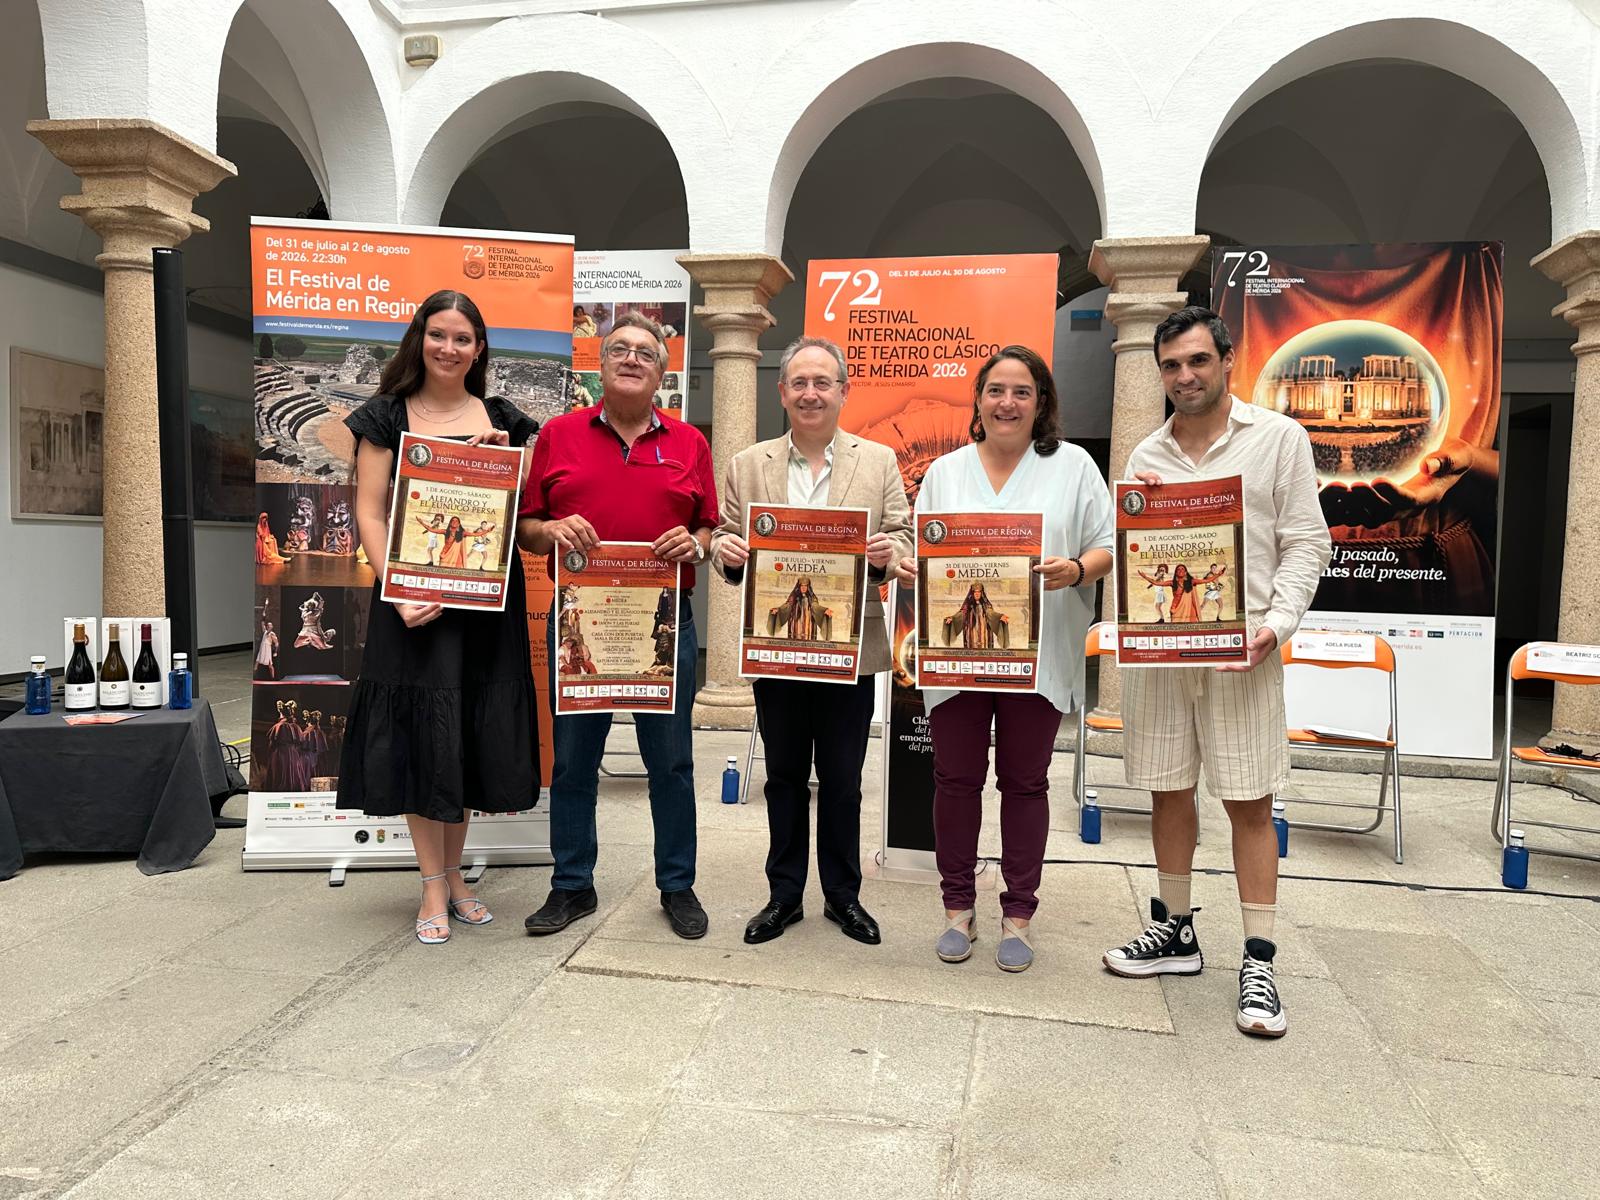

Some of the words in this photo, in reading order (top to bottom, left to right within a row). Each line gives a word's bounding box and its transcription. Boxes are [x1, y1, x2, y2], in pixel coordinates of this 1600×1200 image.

[266, 237, 282, 248] Del
[286, 238, 297, 248] 31
[301, 239, 313, 249] de
[316, 240, 338, 251] julio
[340, 242, 350, 252] al
[352, 242, 359, 252] 2
[362, 243, 374, 252] de
[376, 244, 410, 255] agosto
[266, 251, 278, 260] de
[281, 252, 310, 262] 2026.
[312, 254, 346, 264] 22:30h
[463, 245, 484, 260] 72
[488, 255, 542, 264] INTERNACIONAL
[1223, 250, 1270, 287] 72
[266, 268, 282, 286] El
[290, 270, 362, 290] Festival
[368, 274, 390, 292] de
[578, 270, 642, 279] INTERNACIONAL
[584, 280, 618, 288] CLÁSICO
[664, 280, 682, 288] 2026
[266, 290, 330, 311] Mérida
[336, 299, 358, 312] en
[818, 270, 882, 322] 72
[849, 310, 918, 324] FESTIVAL
[848, 327, 975, 342] INTERNACIONAL
[848, 346, 866, 360] DE
[872, 346, 929, 360] TEATRO
[848, 364, 866, 378] DE
[870, 360, 928, 378] MÉRIDA
[932, 363, 967, 378] 2026
[436, 456, 470, 466] FESTIVAL
[429, 495, 480, 506] ALEJANDRO
[1150, 500, 1188, 508] FESTIVAL
[432, 502, 470, 512] EUNUCO
[472, 506, 496, 514] PERSA
[781, 524, 813, 532] FESTIVAL
[1148, 542, 1205, 552] ALEJANDRO
[1152, 550, 1194, 559] EUNUCO
[1198, 548, 1224, 556] PERSA
[1340, 547, 1399, 564] pasado,
[786, 563, 826, 573] MEDEA
[958, 568, 1000, 578] MEDEA
[1354, 564, 1376, 578] del
[1377, 568, 1446, 582] presente.
[915, 725, 927, 734] del
[900, 734, 932, 742] emocio
[908, 742, 920, 751] del
